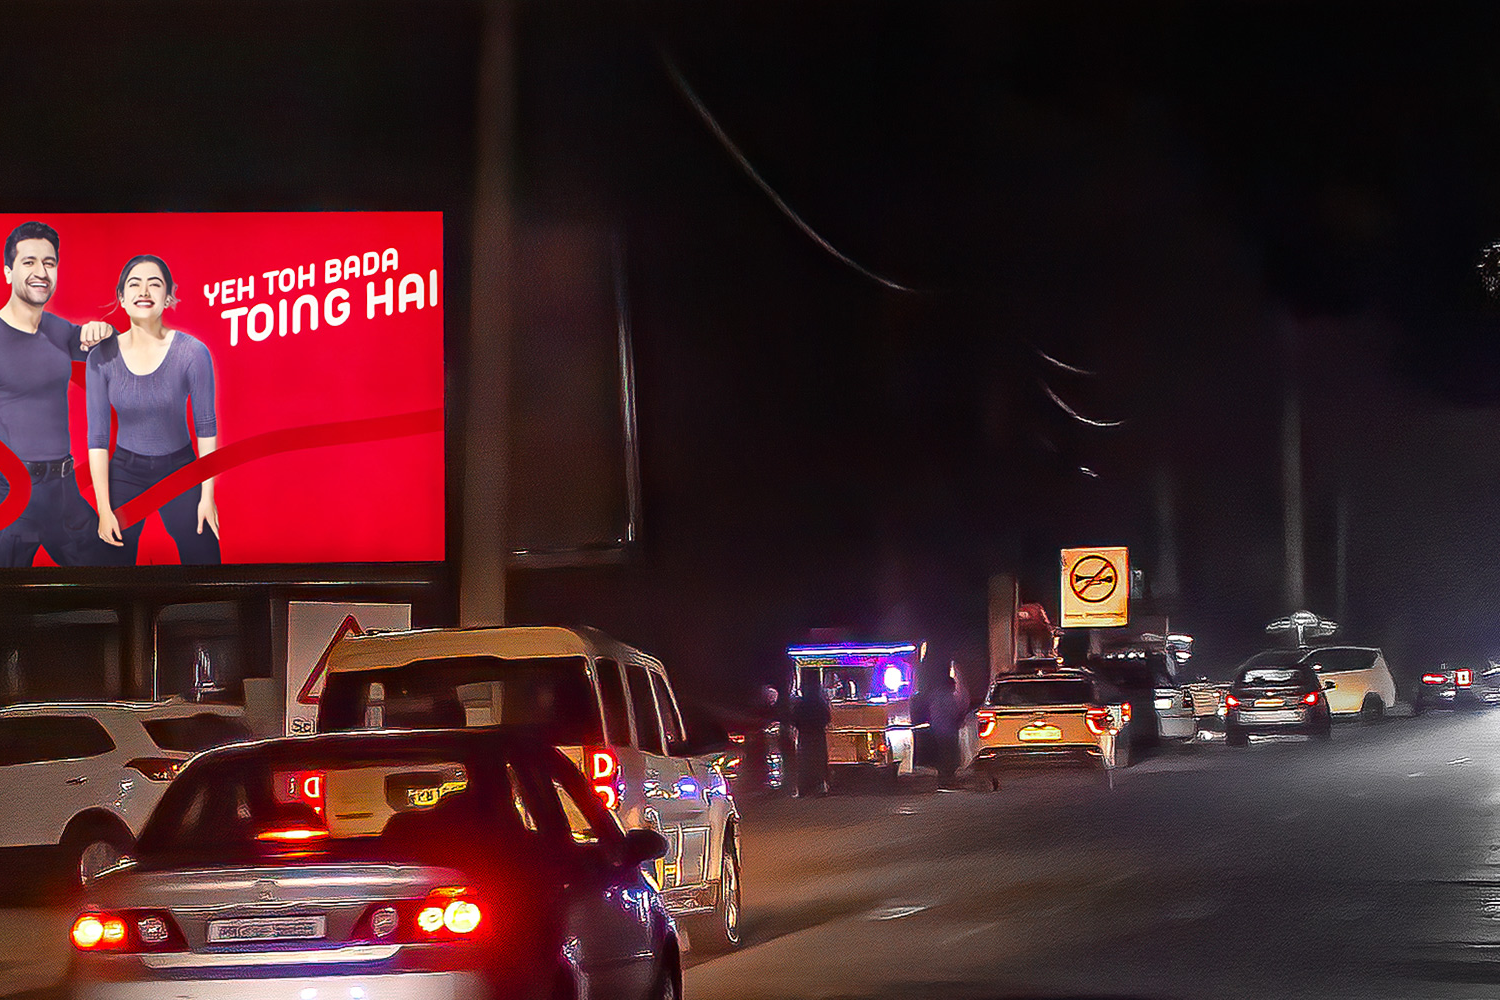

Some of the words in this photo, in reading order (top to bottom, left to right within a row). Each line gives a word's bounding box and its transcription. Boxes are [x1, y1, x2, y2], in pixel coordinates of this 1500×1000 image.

[203, 275, 255, 307] YEH
[262, 263, 315, 296] TOH
[325, 247, 399, 284] BADA
[220, 287, 351, 347] TOING
[366, 269, 438, 320] HAI
